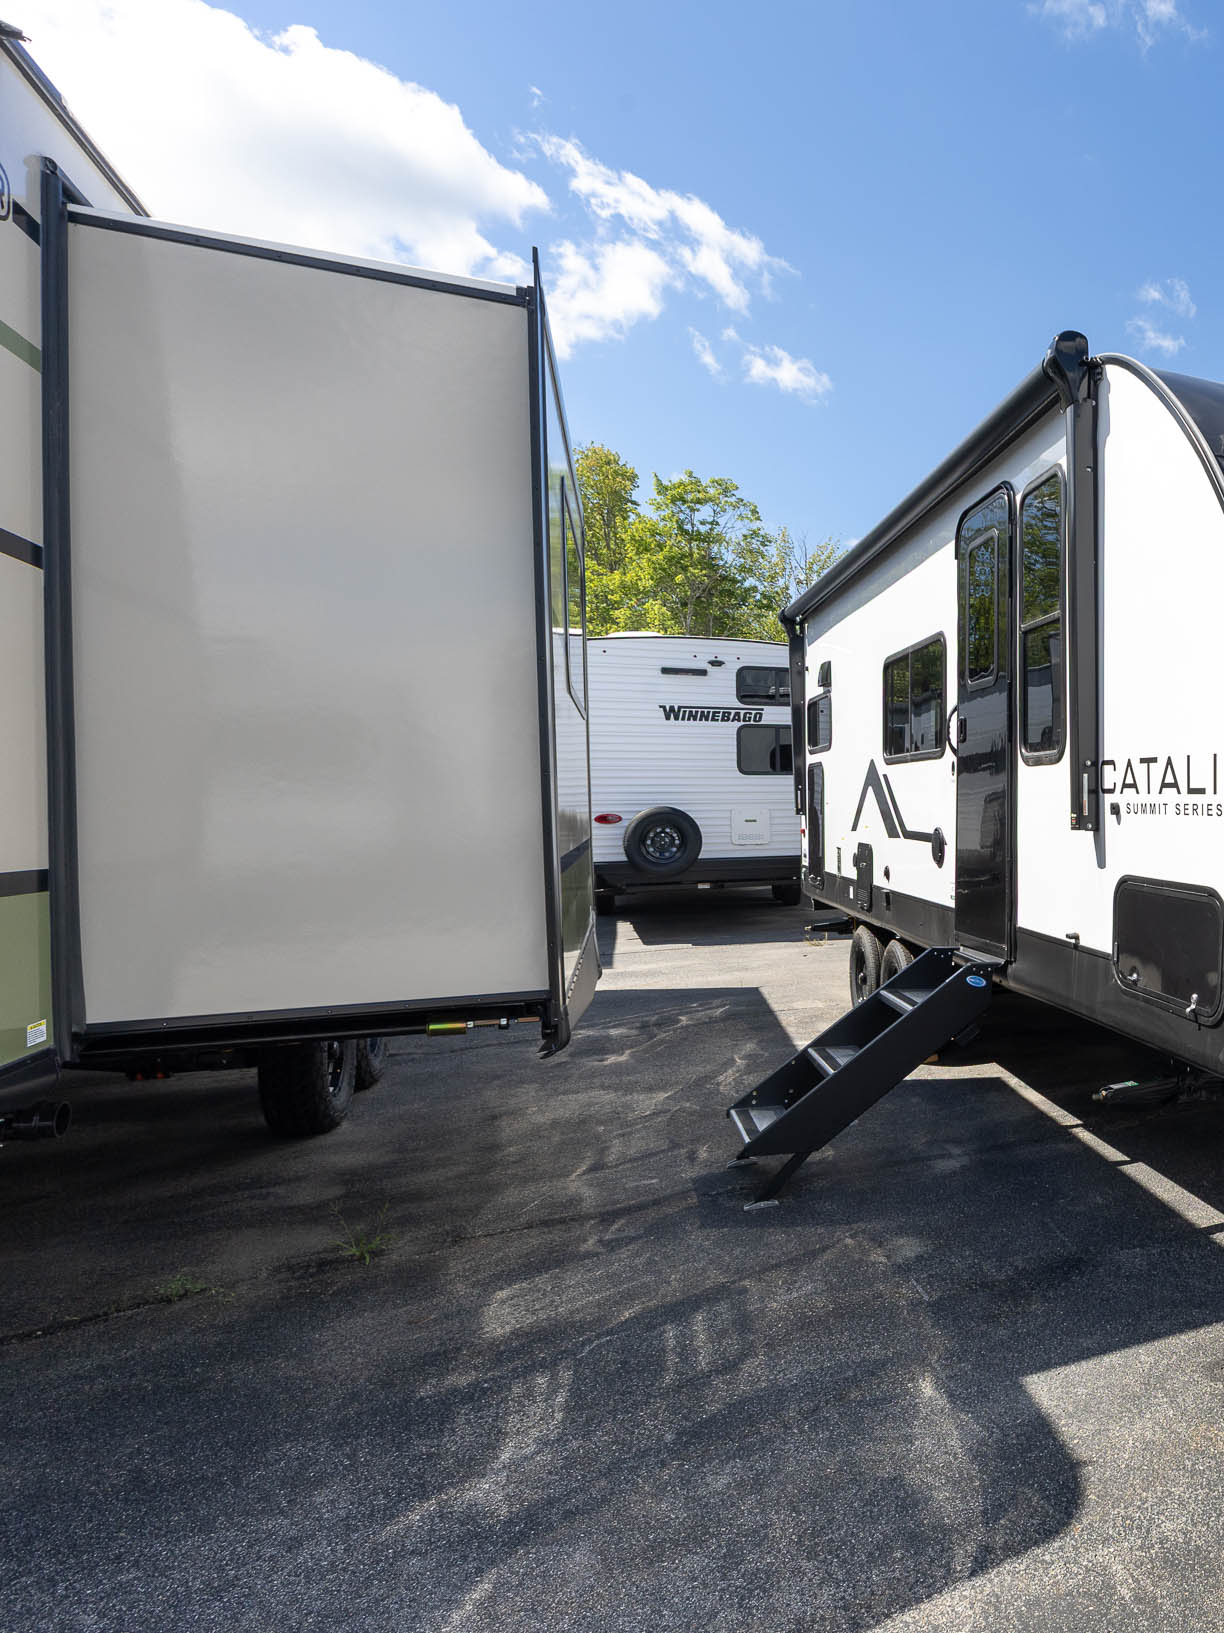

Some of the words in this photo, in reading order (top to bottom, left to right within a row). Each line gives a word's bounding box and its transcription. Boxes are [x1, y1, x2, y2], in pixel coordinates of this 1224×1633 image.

[659, 705, 764, 723] WINNEBAGO
[1126, 803, 1169, 815] SUMMIT
[1175, 803, 1223, 816] SERIES
